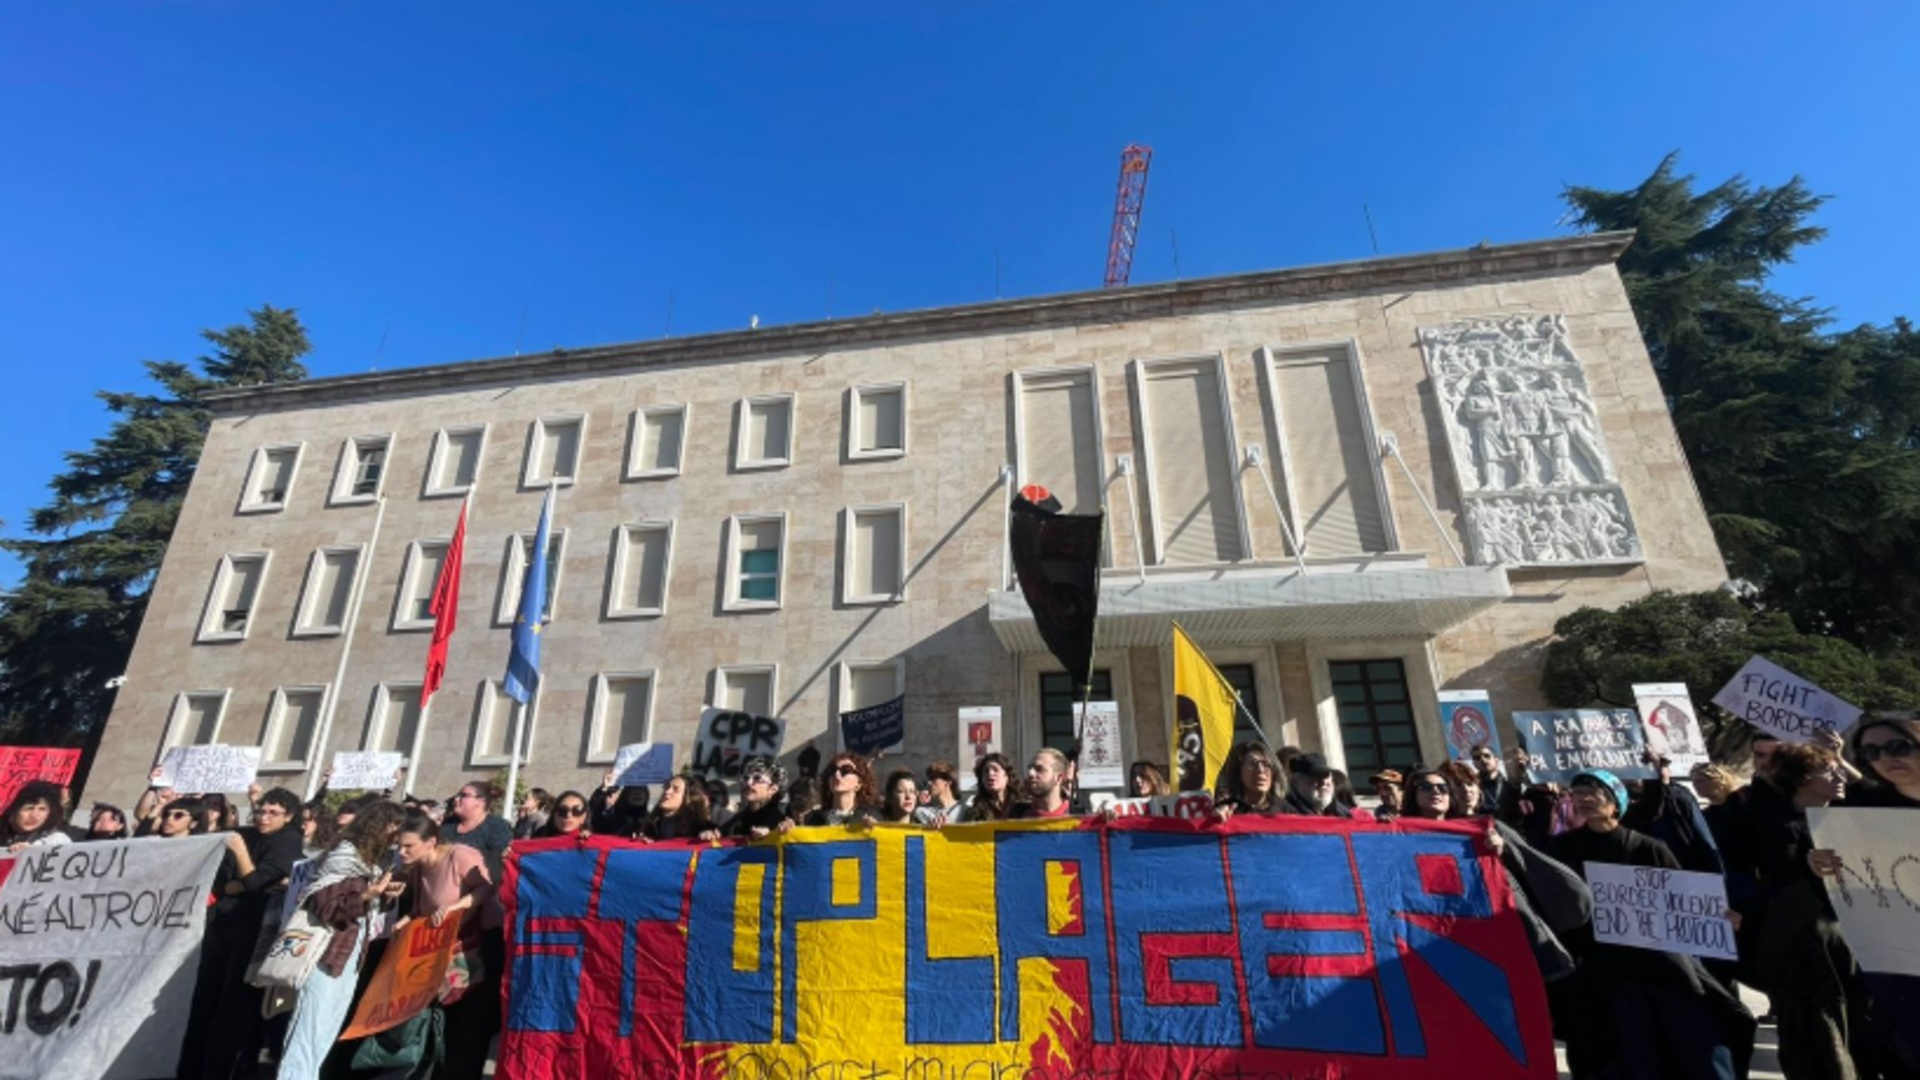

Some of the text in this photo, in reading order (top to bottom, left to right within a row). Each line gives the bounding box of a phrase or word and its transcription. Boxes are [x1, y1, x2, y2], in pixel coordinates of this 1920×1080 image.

[1741, 673, 1817, 708] FIGHT
[710, 711, 779, 751] CPR
[1532, 719, 1547, 736] A
[19, 845, 129, 884] NÉ QUI
[1634, 867, 1672, 890] STOP
[44, 884, 200, 932] ALTROVE!
[1592, 881, 1725, 919] BORDER VIOLENCE
[506, 829, 1529, 1068] STOP LAGER
[1594, 906, 1739, 956] END THE PROTOCOL
[0, 958, 102, 1036] TO!
